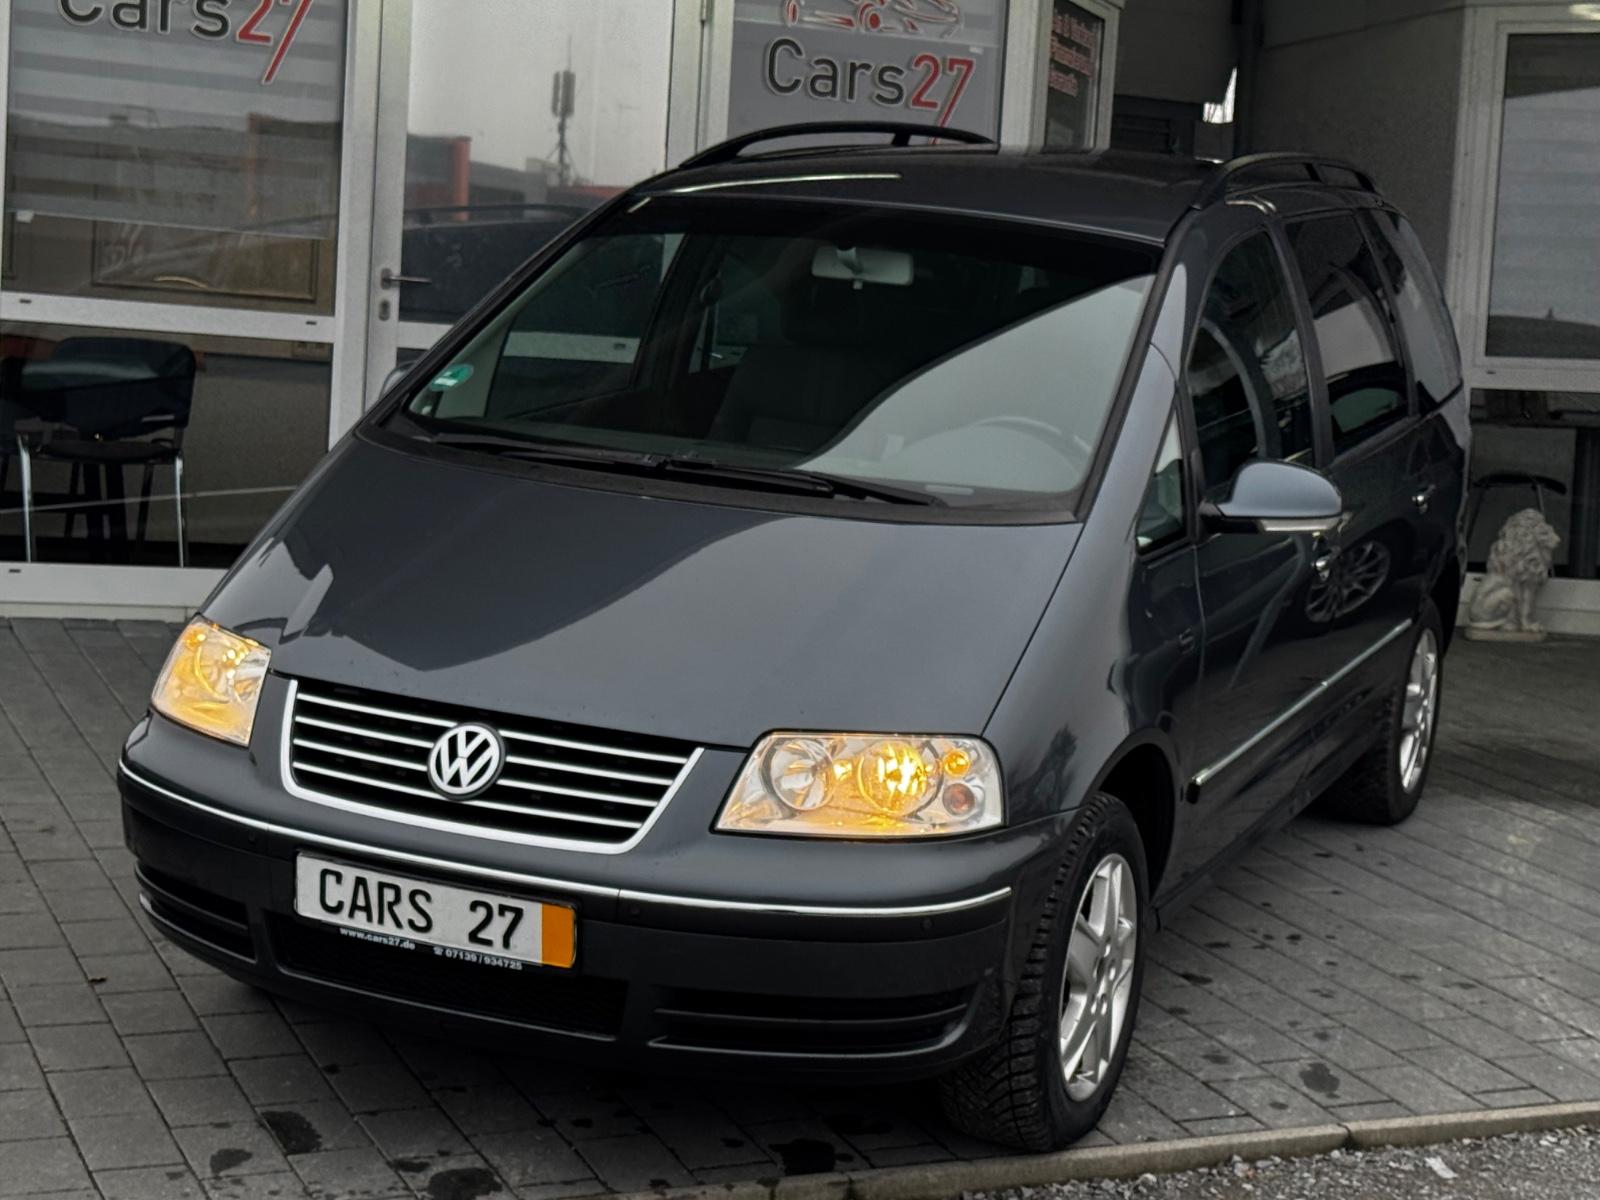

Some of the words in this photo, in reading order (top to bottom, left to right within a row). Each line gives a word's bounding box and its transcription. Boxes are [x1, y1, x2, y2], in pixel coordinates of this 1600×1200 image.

[765, 38, 976, 144] Cars27
[429, 725, 500, 795] VW
[319, 868, 433, 933] CARS
[468, 900, 524, 949] 27
[340, 927, 416, 950] www.cars27.de
